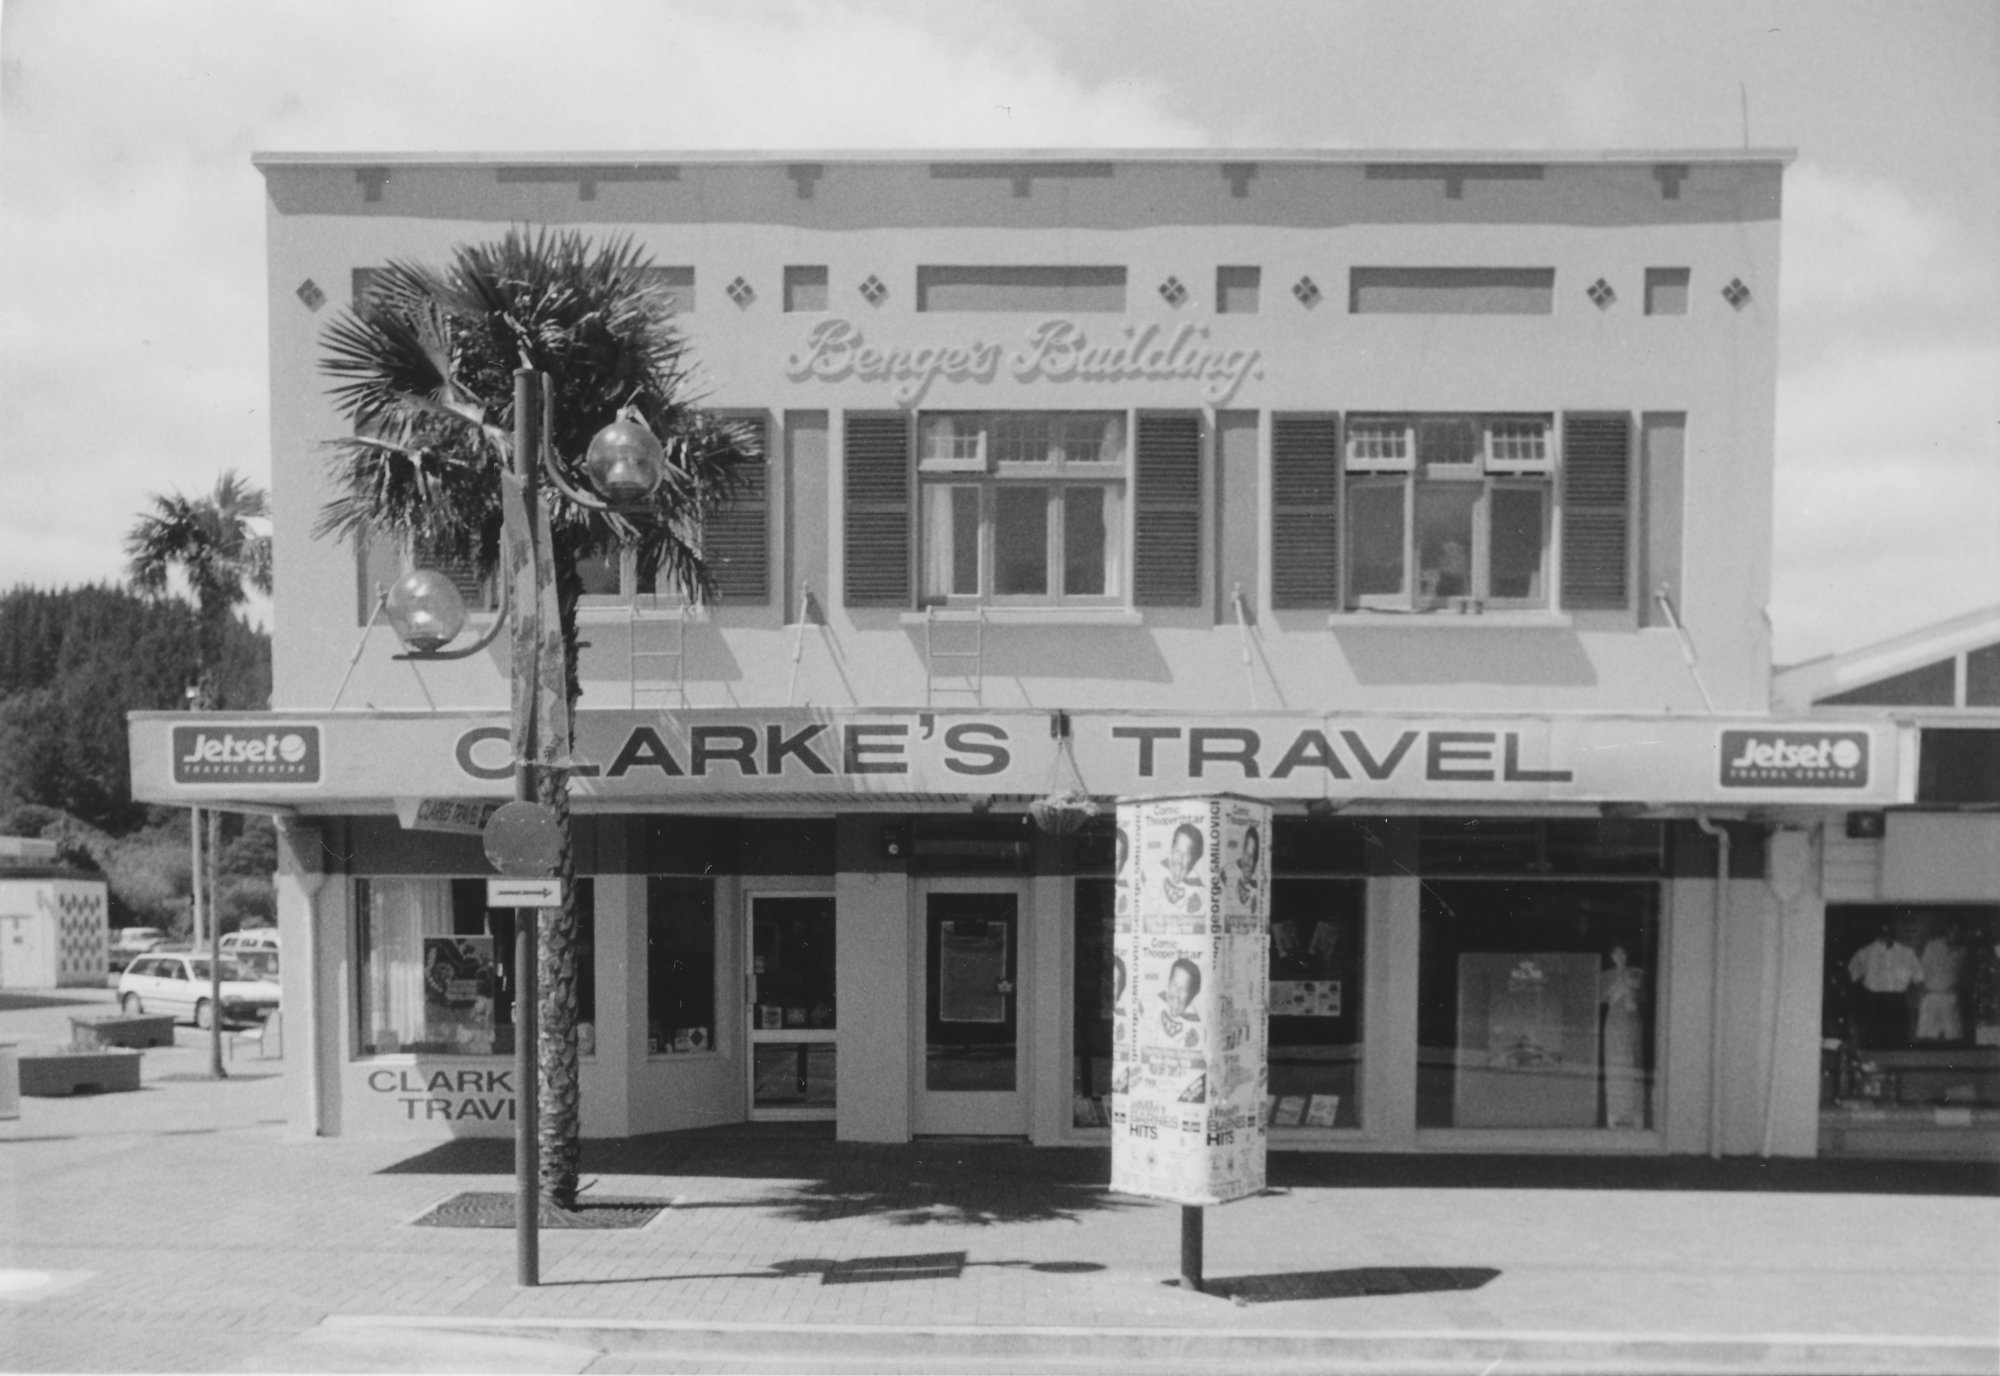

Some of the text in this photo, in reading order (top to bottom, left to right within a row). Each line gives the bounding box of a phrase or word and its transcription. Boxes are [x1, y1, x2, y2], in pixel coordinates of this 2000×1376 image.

[182, 733, 280, 763] Jetset
[1111, 726, 1574, 783] TRAVEL
[1731, 738, 1833, 768] Jetset
[183, 764, 305, 774] TRAVEL CENTRE
[1209, 801, 1221, 873] SMILOVICI
[1209, 877, 1222, 934] george
[367, 1069, 516, 1093] CLARK
[397, 1098, 516, 1121] TRAV
[1130, 1111, 1179, 1130] BARNES
[1129, 1123, 1159, 1140] HITS
[1206, 1130, 1235, 1146] HITS
